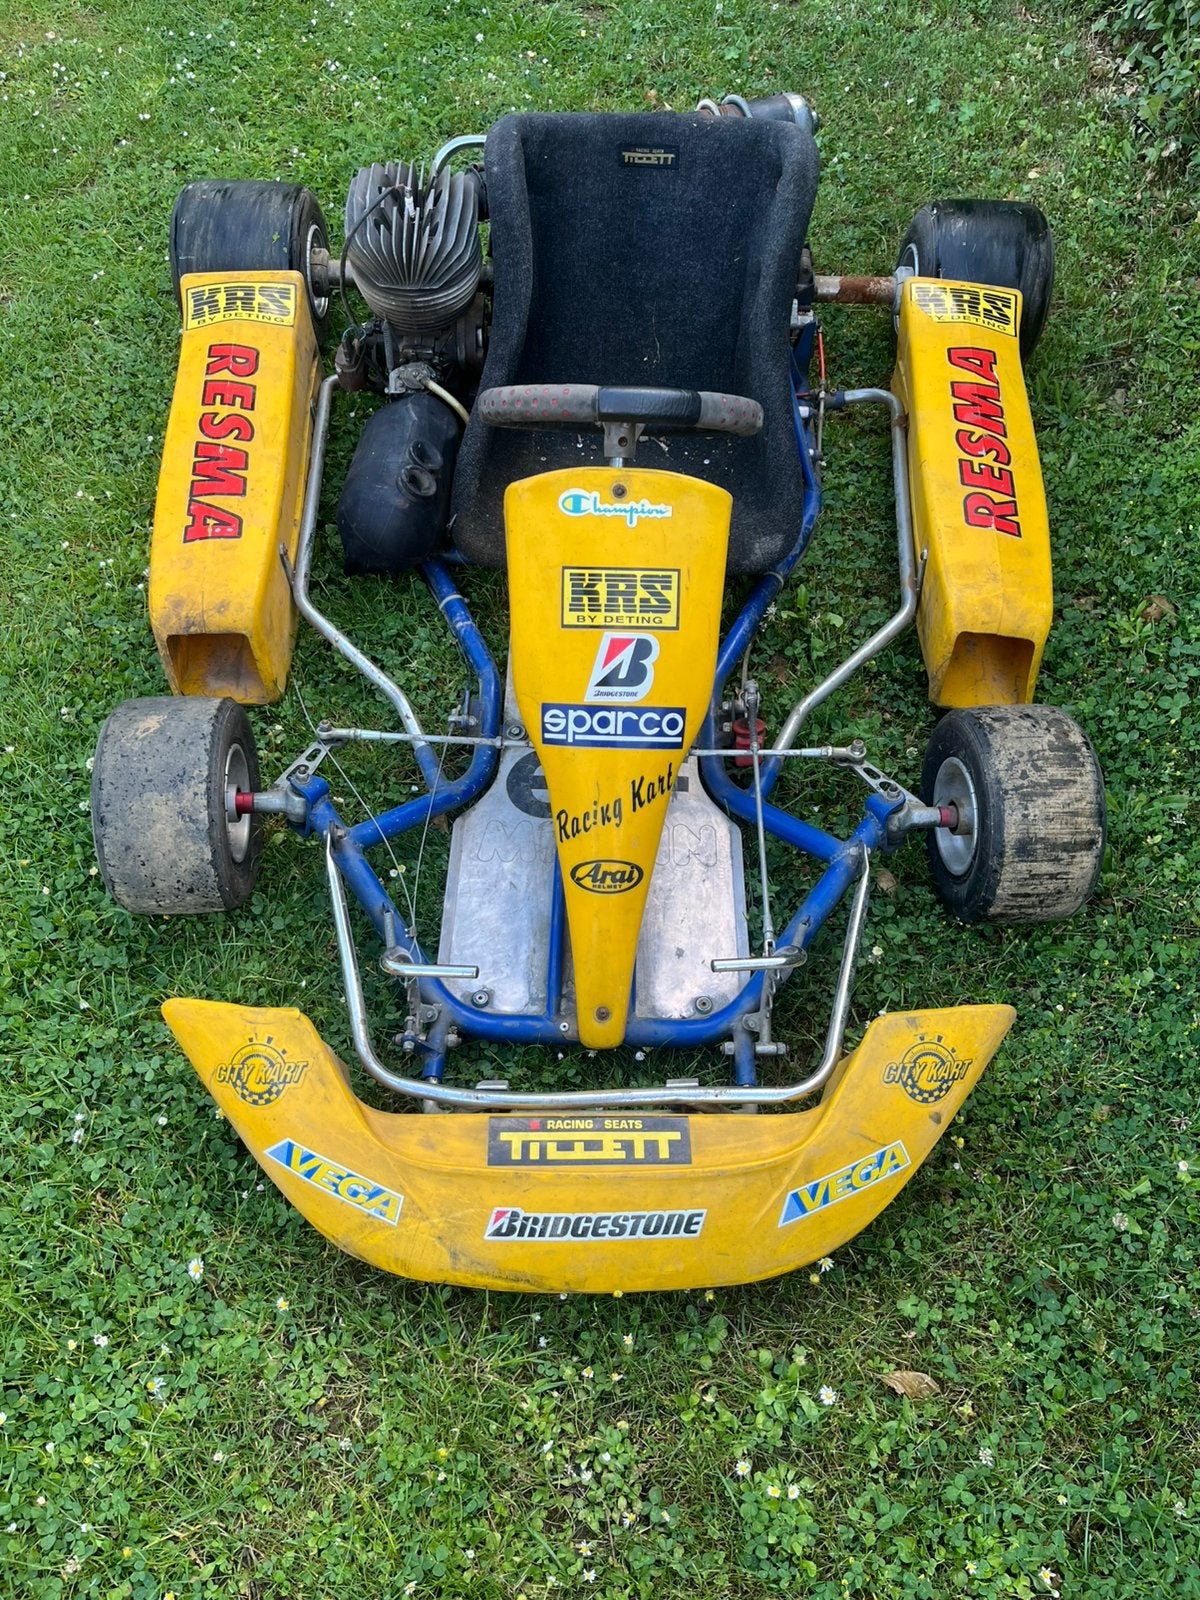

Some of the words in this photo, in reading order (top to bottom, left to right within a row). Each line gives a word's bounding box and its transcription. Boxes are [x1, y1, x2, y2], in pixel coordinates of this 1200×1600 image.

[191, 286, 290, 320] KRS
[197, 315, 216, 325] BY
[223, 312, 284, 323] DETING
[915, 286, 1011, 326] KRS
[951, 315, 1006, 331] DETING
[183, 343, 260, 543] RESMA
[947, 347, 1022, 538] RESMA
[561, 494, 668, 525] Champion
[569, 573, 672, 614] KRS
[576, 615, 597, 623] BY
[604, 616, 663, 624] DETING
[593, 690, 639, 698] BRIDGESTONE
[544, 709, 684, 743] sparco
[556, 798, 623, 843] Racing
[631, 762, 673, 812] Kart
[574, 863, 636, 884] Arai
[215, 1062, 256, 1084] CITY
[255, 1061, 309, 1084] KART
[883, 1062, 928, 1084] CITY
[926, 1059, 973, 1083] KART
[547, 1120, 594, 1129] RACING
[604, 1120, 643, 1129] SEATS
[287, 1145, 402, 1222] VEGA
[797, 1145, 908, 1211] VEGA
[487, 1210, 704, 1238] BRIDGESTONE
